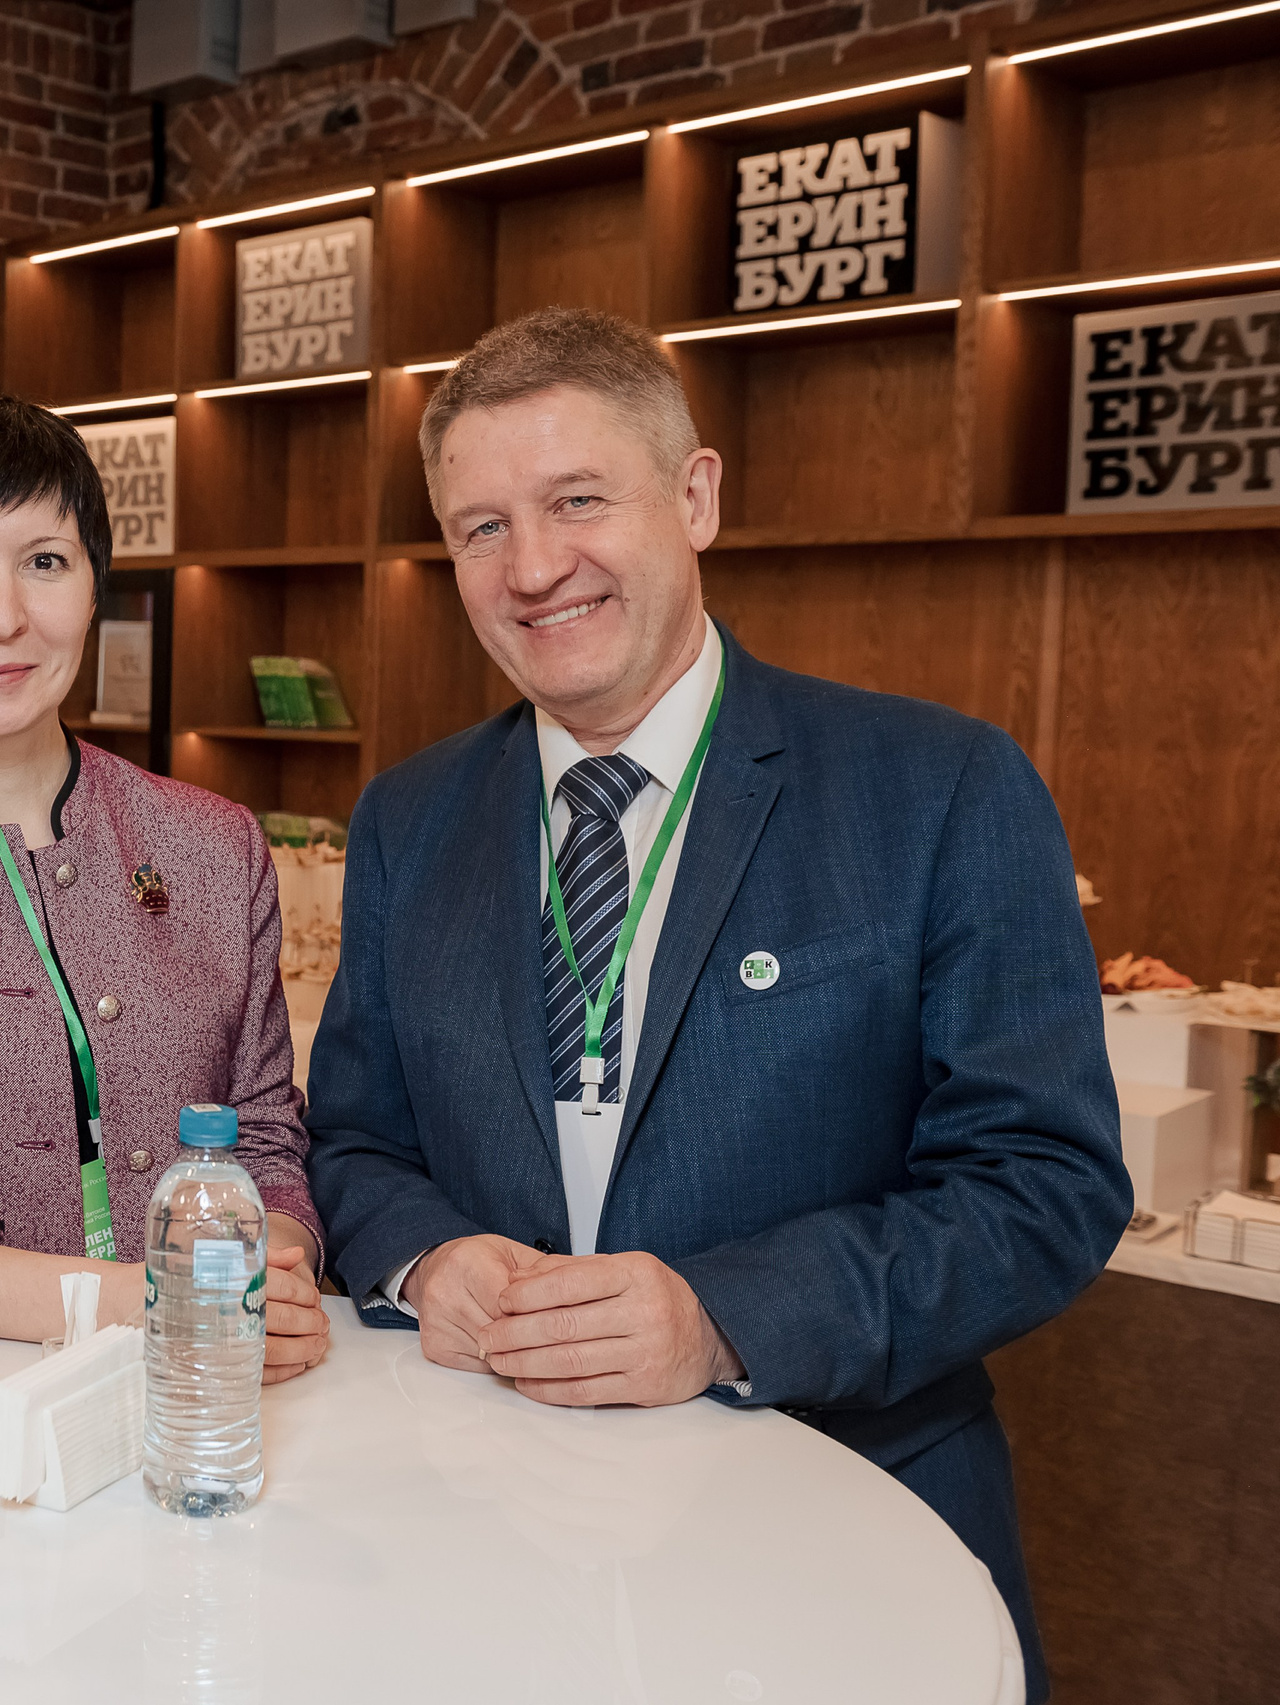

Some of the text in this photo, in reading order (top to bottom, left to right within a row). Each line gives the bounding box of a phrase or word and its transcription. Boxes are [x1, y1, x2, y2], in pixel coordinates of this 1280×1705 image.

[736, 127, 911, 208] ЕКАТ
[736, 183, 909, 260] ЕРИН
[242, 231, 357, 290] ЕКАТ
[734, 238, 906, 312] БУРГ
[241, 275, 356, 332] ЕРИН
[241, 319, 355, 375] БУРГ
[86, 433, 165, 470] КАТ
[1083, 437, 1280, 500] БУРГ
[85, 1226, 113, 1248] ЛЕН
